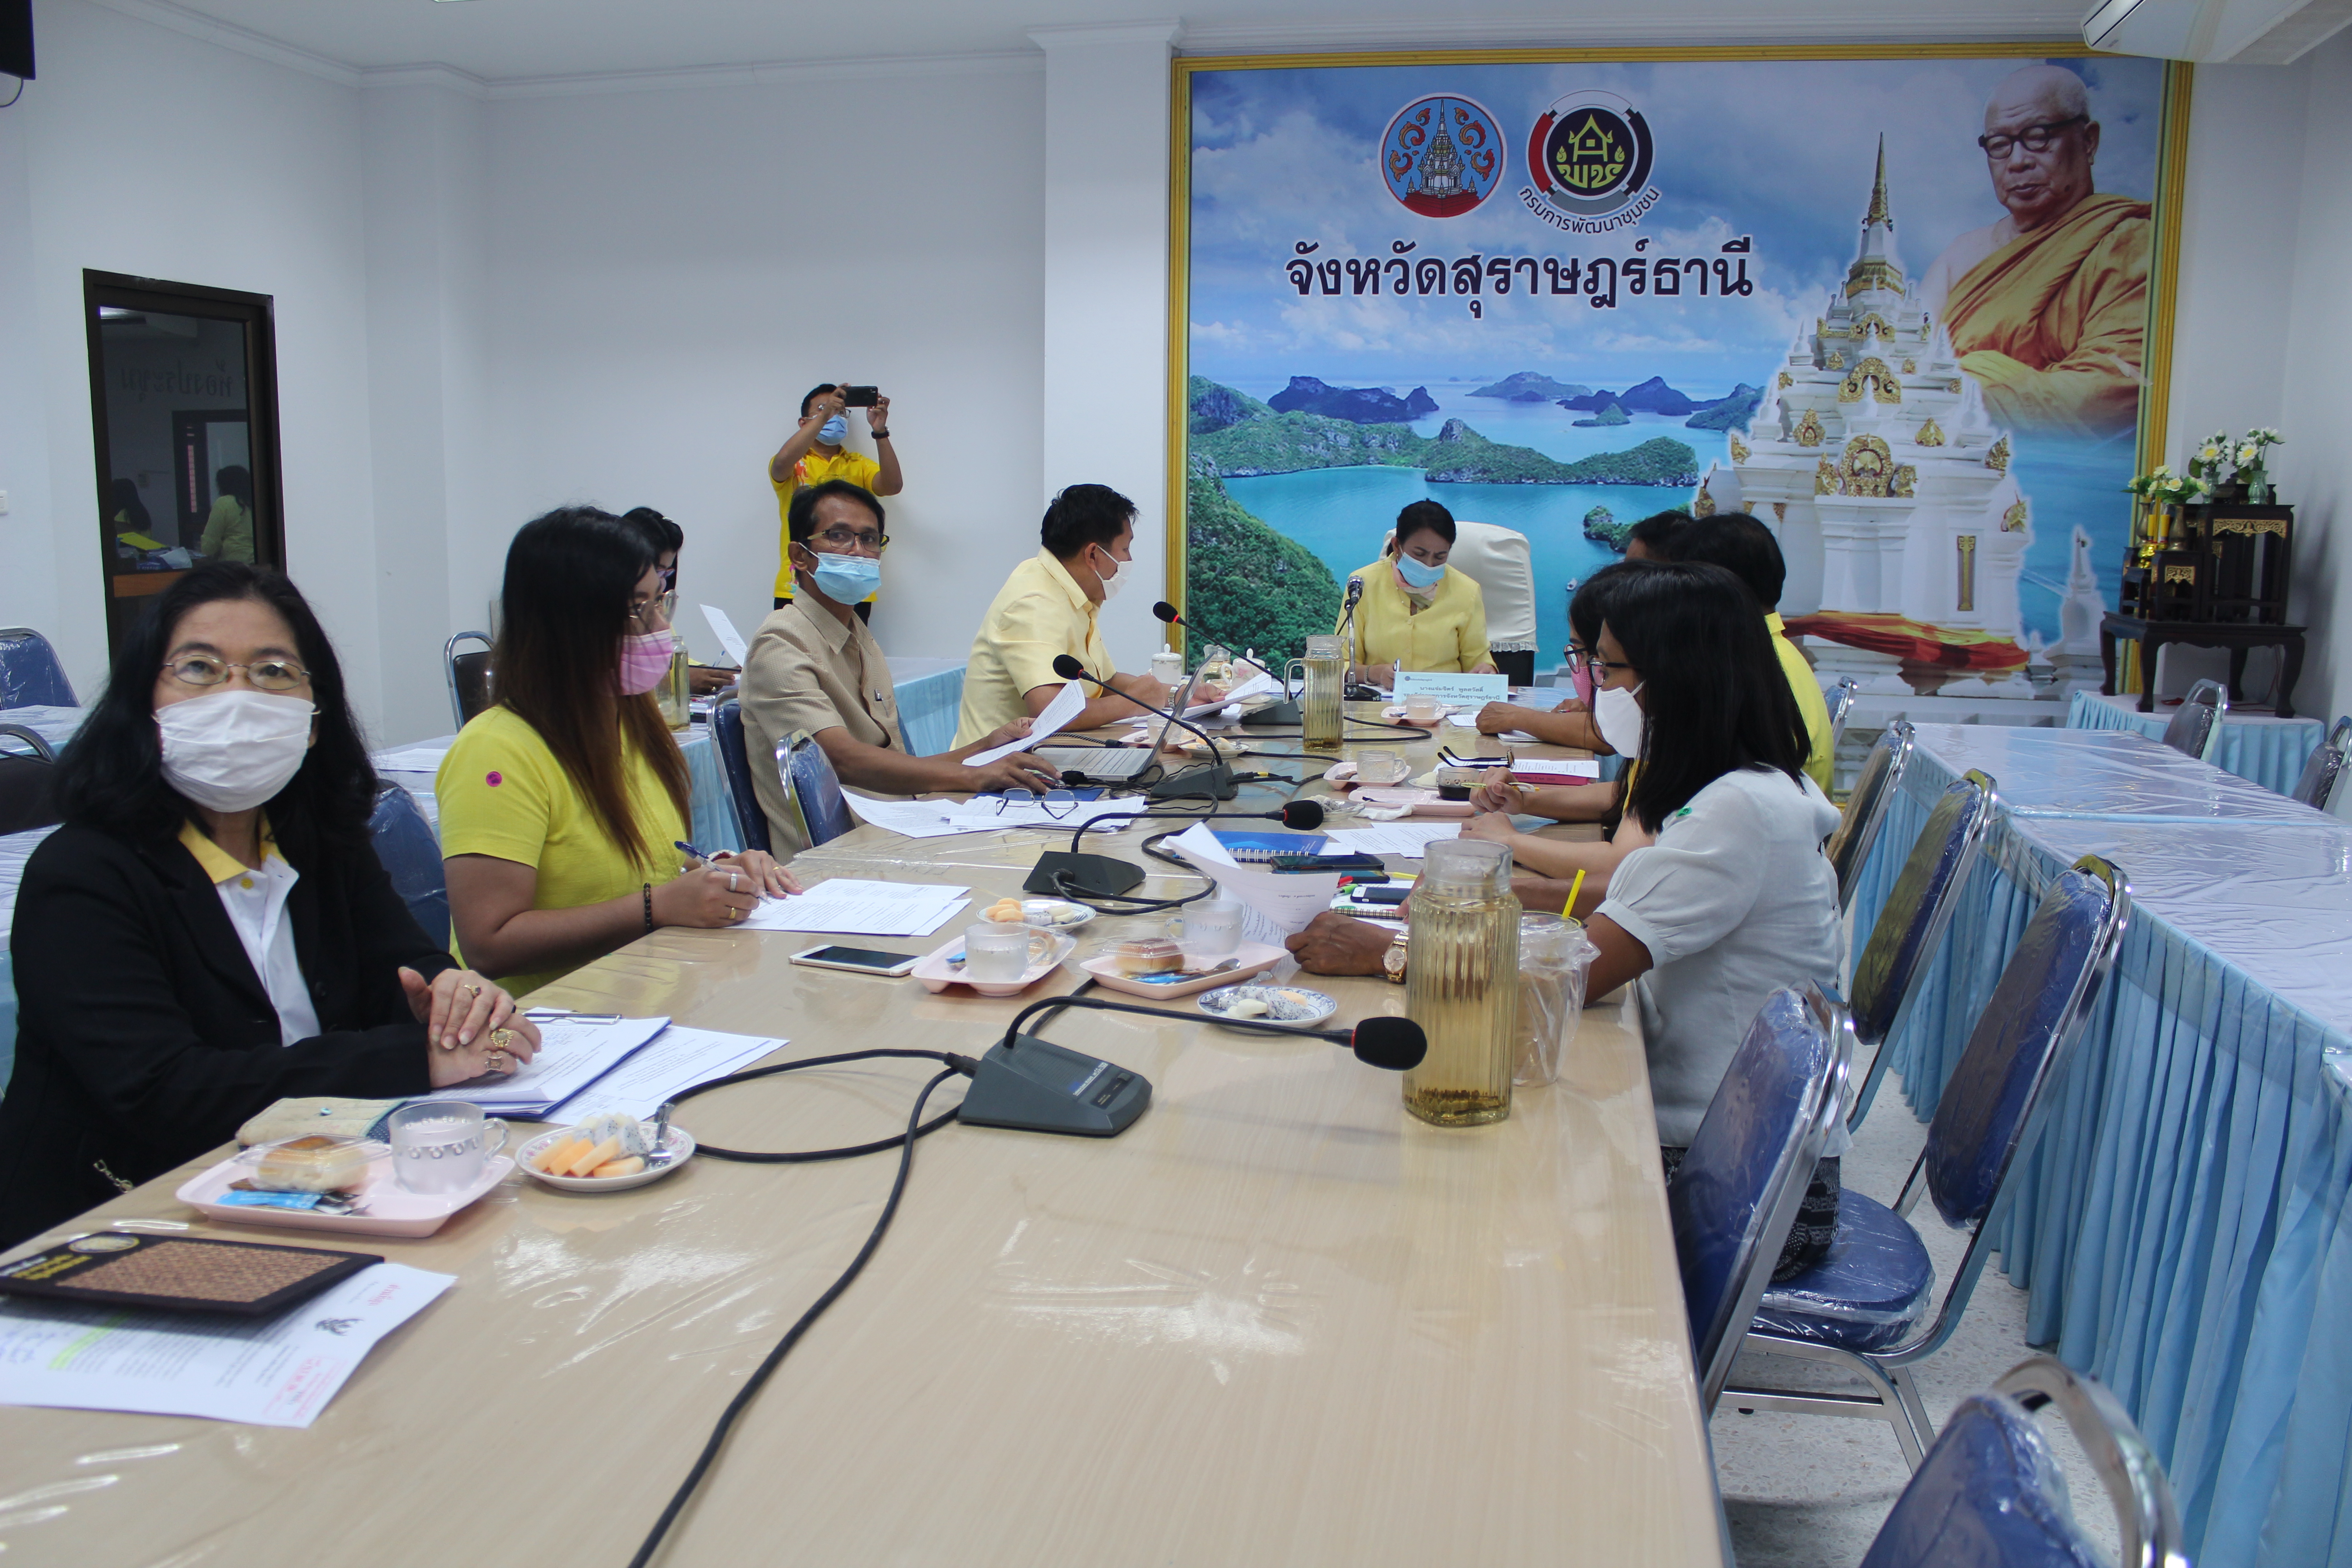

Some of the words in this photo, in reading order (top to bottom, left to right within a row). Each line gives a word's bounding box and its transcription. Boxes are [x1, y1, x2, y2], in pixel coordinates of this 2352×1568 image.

[1519, 187, 1660, 234] กรมการพัฒนาชุมชน
[1286, 237, 1753, 318] จังหวัดสุราษฎร์ธานี
